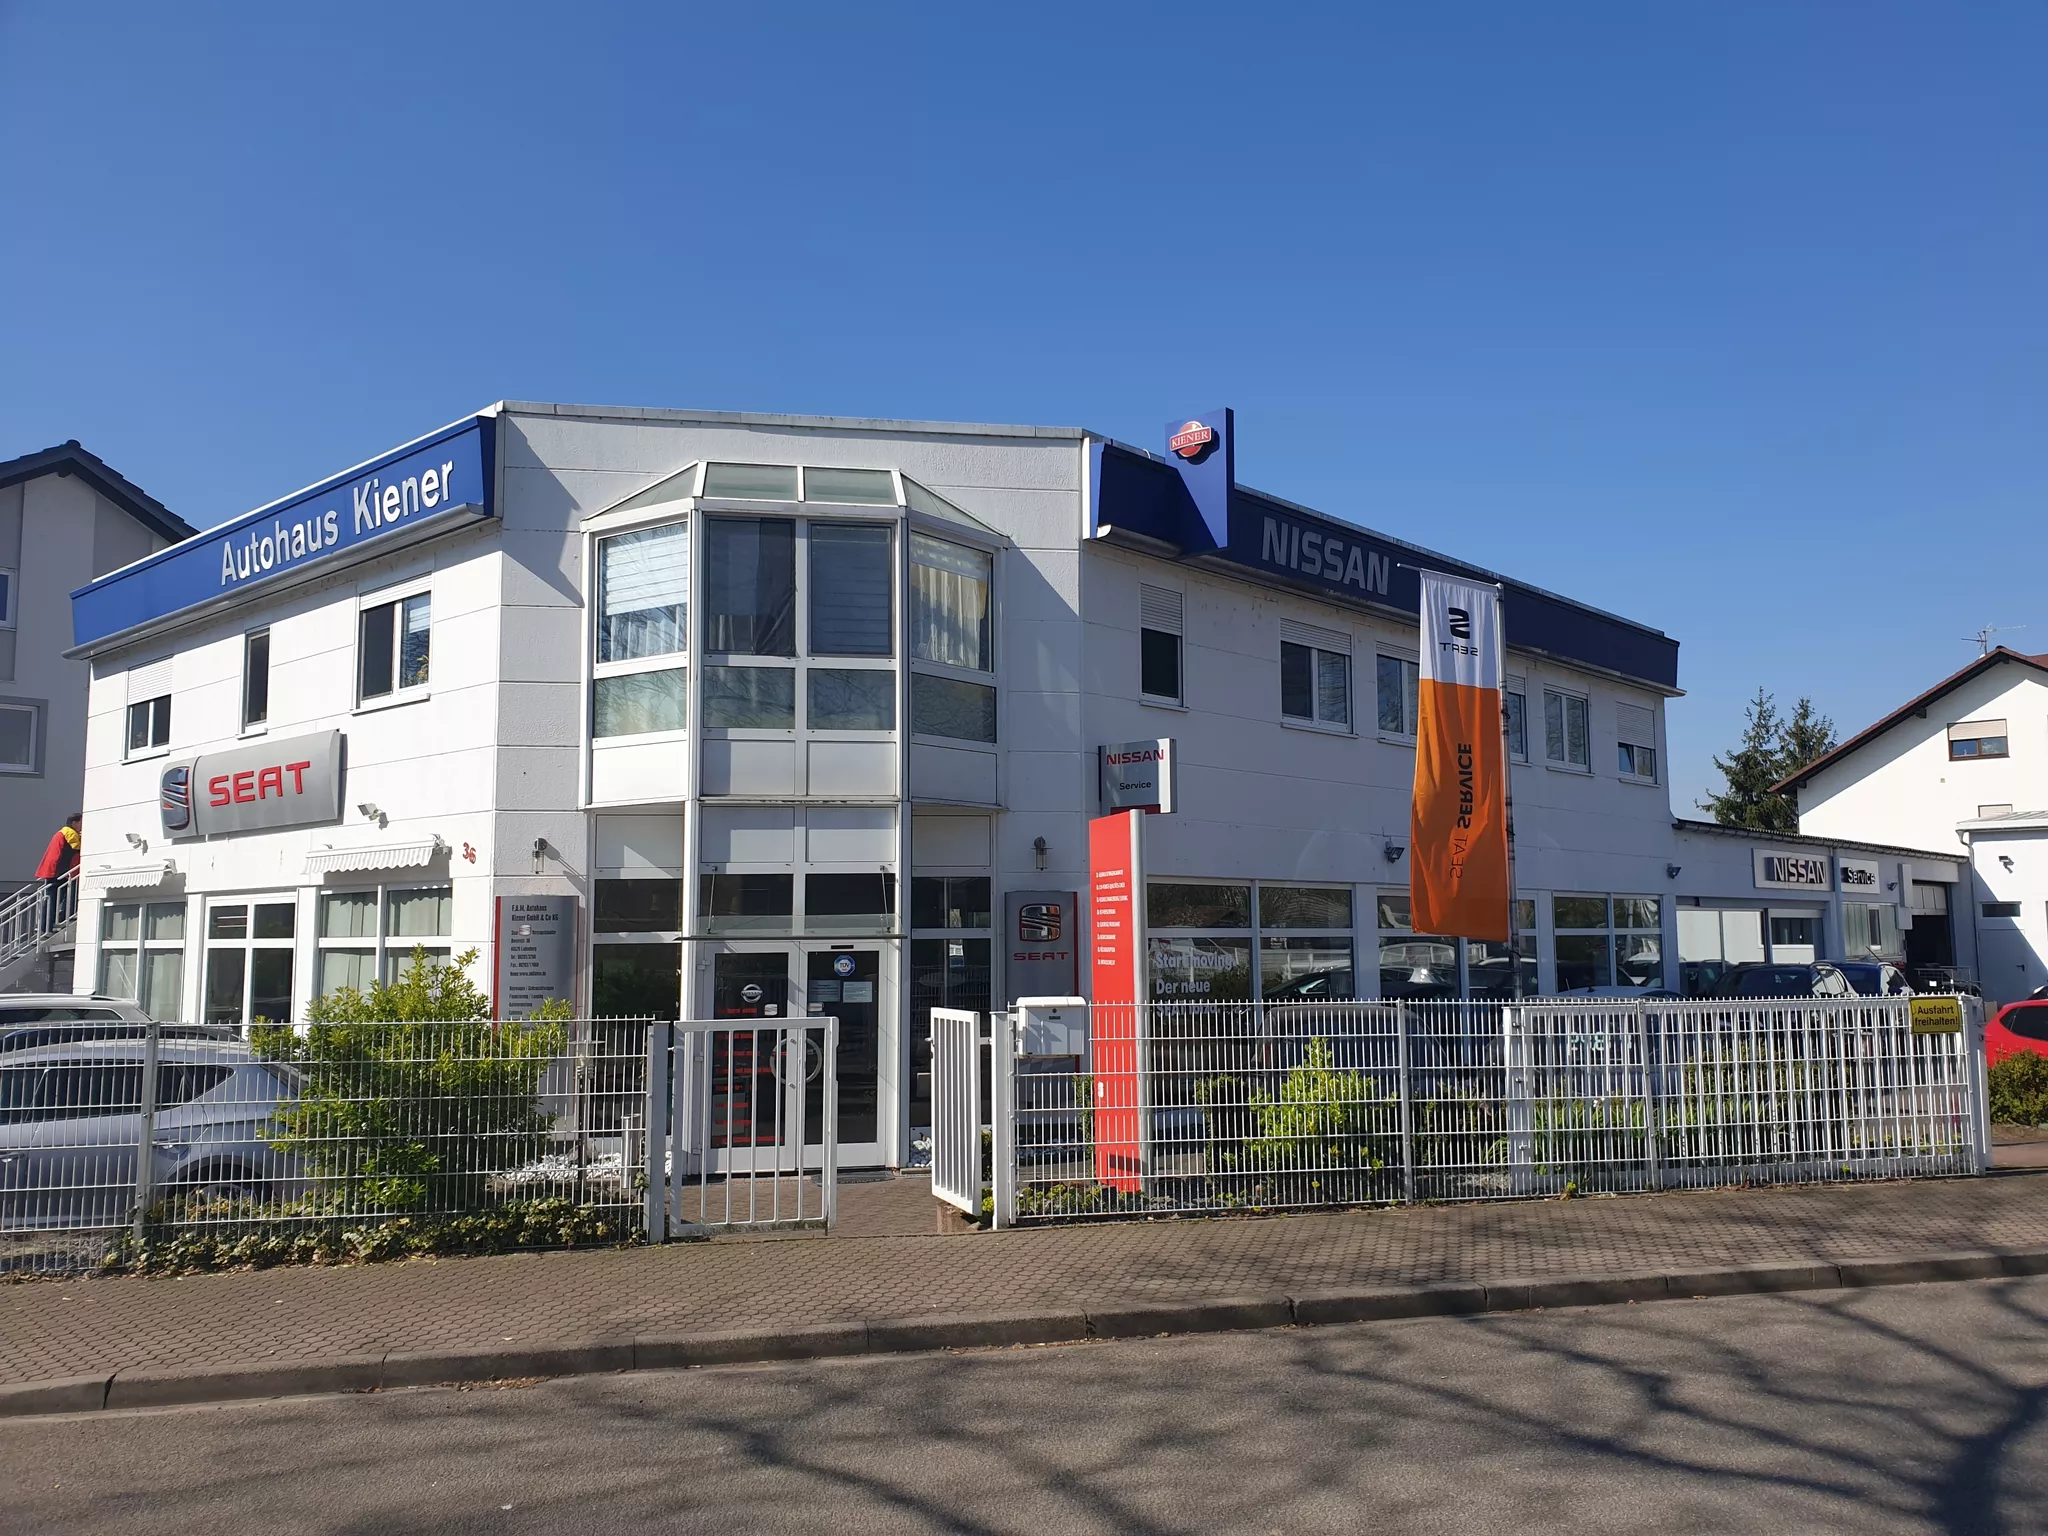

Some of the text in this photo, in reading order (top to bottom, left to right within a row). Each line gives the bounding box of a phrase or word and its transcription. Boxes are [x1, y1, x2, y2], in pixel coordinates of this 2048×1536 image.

[1171, 430, 1209, 448] KIENER
[220, 461, 453, 586] Autohaus Kiener
[1261, 516, 1390, 595] NISSAN
[1106, 749, 1164, 765] NISSAN
[208, 760, 311, 807] SEAT
[1119, 780, 1152, 791] Service
[462, 841, 477, 864] 36
[1773, 857, 1827, 884] NISSAN
[1847, 867, 1876, 885] Service
[1013, 952, 1068, 961] SEAT
[1155, 951, 1190, 969] Start
[1156, 979, 1211, 994] Der neue
[1917, 1006, 1954, 1016] Ausfahrt
[1915, 1016, 1958, 1027] freihalten!
